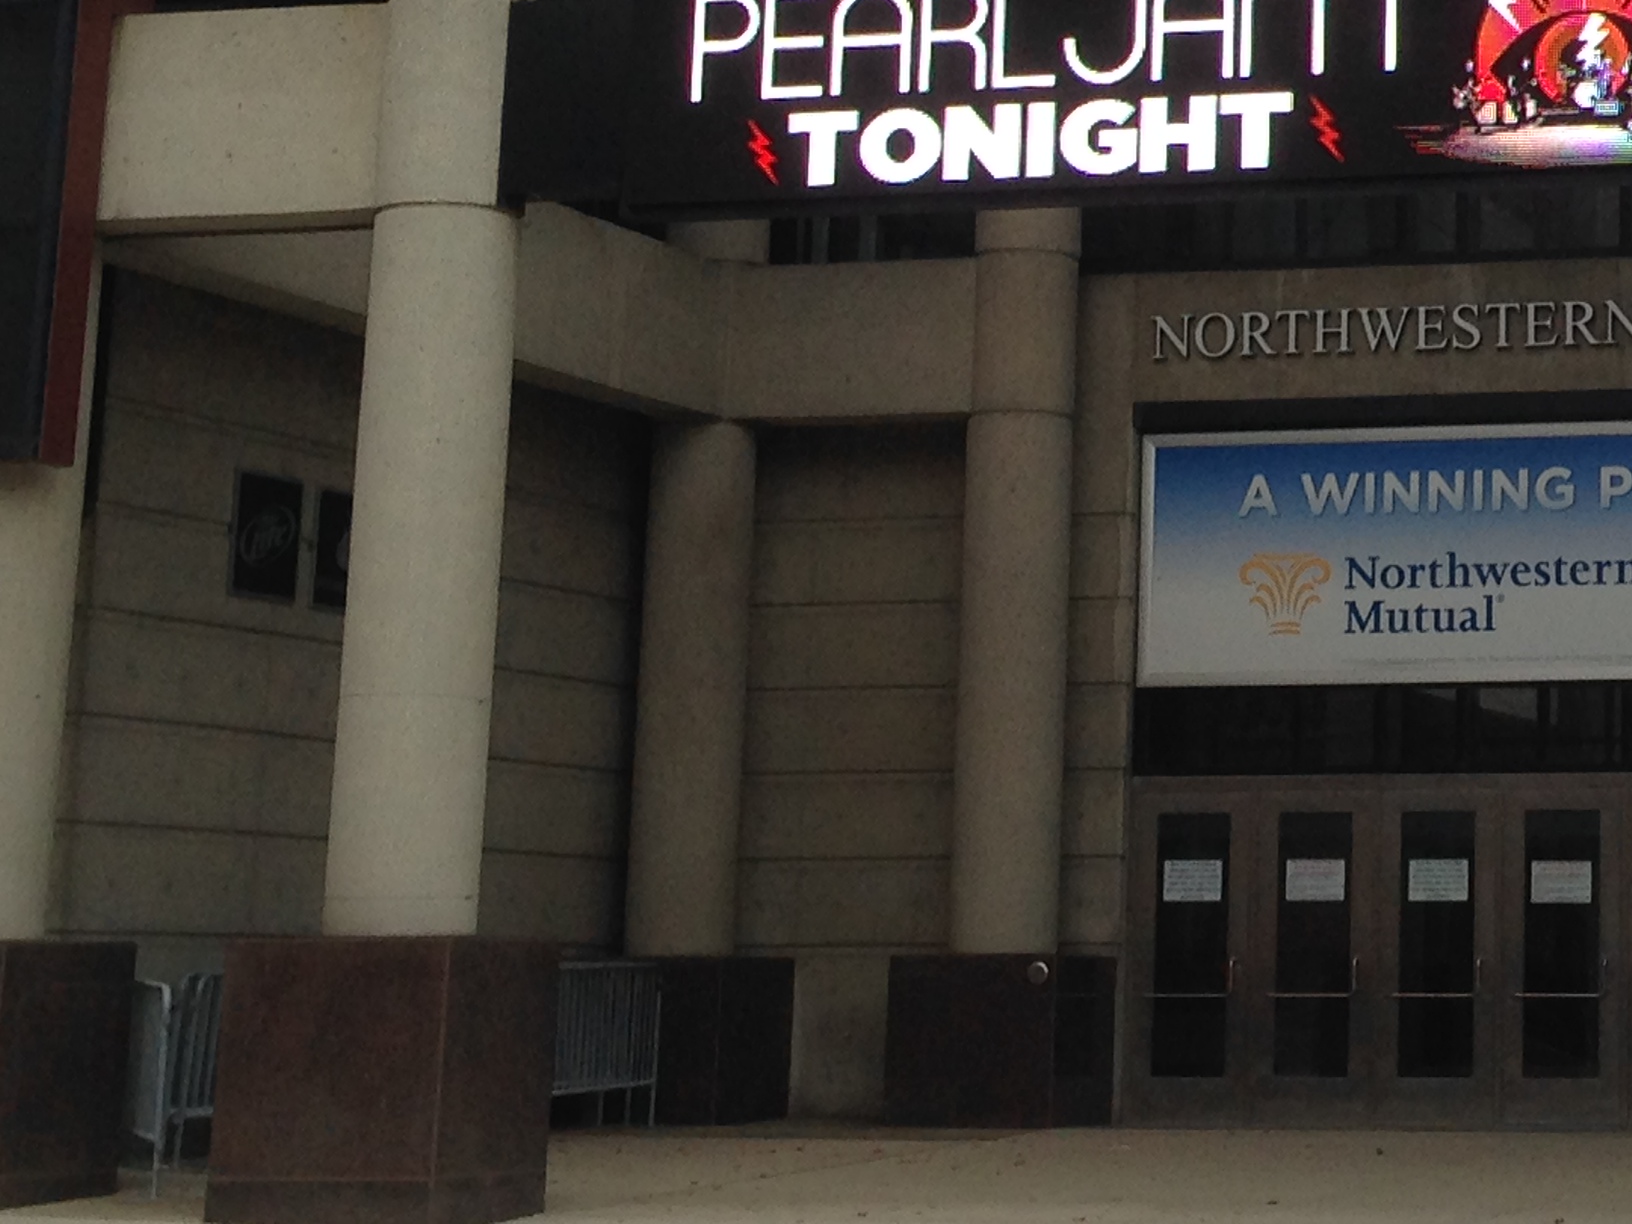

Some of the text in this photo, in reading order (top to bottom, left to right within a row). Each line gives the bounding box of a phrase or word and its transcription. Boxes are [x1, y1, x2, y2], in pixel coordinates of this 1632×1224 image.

[787, 91, 1294, 187] TONIGHT
[1239, 473, 1278, 519] A
[1302, 466, 1575, 516] WINNING
[1343, 594, 1499, 635] Mutual
